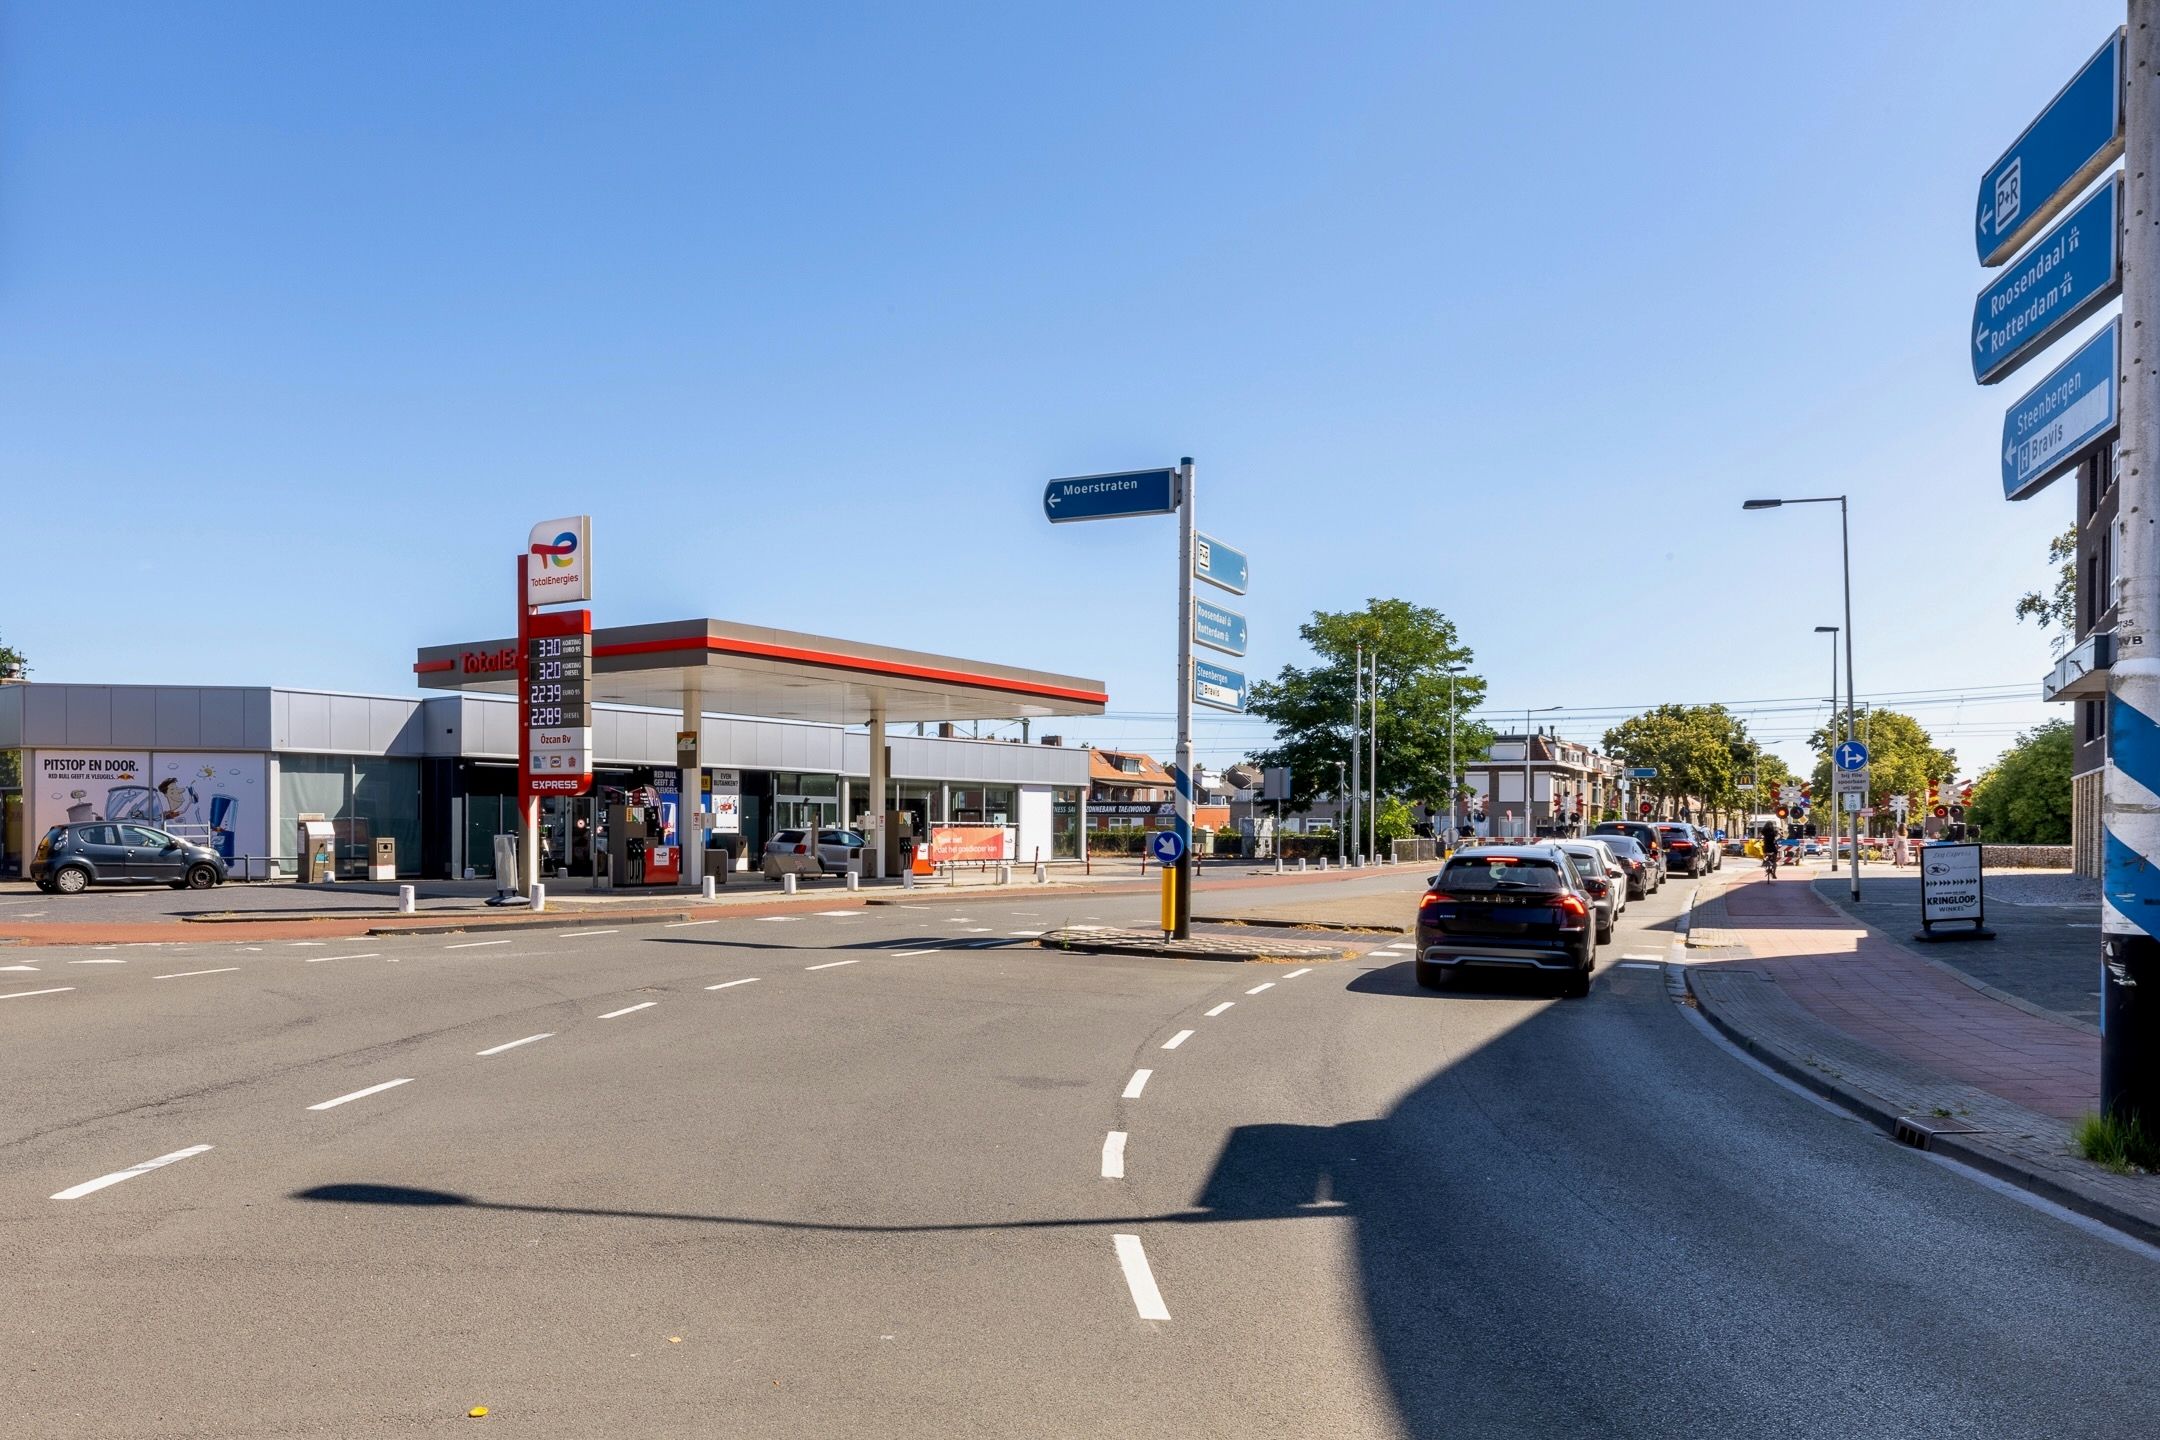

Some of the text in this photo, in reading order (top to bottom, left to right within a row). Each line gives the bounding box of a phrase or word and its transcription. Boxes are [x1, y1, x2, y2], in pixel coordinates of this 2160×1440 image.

[1991, 236, 2065, 318] Roosendaal
[1991, 286, 2058, 353] Rotterdam
[2017, 371, 2081, 436] Steenbergen
[2031, 423, 2063, 461] Bravis
[1063, 480, 1138, 496] Moerstraten
[531, 573, 579, 587] TotalEnergies
[1198, 604, 1228, 625] Roosendaal
[1197, 621, 1225, 641] Rotterdam
[540, 733, 561, 744] Özcan
[44, 759, 139, 772] PITSTOP EN DOOR.
[532, 780, 578, 790] EXPRESS
[1927, 894, 1976, 906] KRINGLOOP
